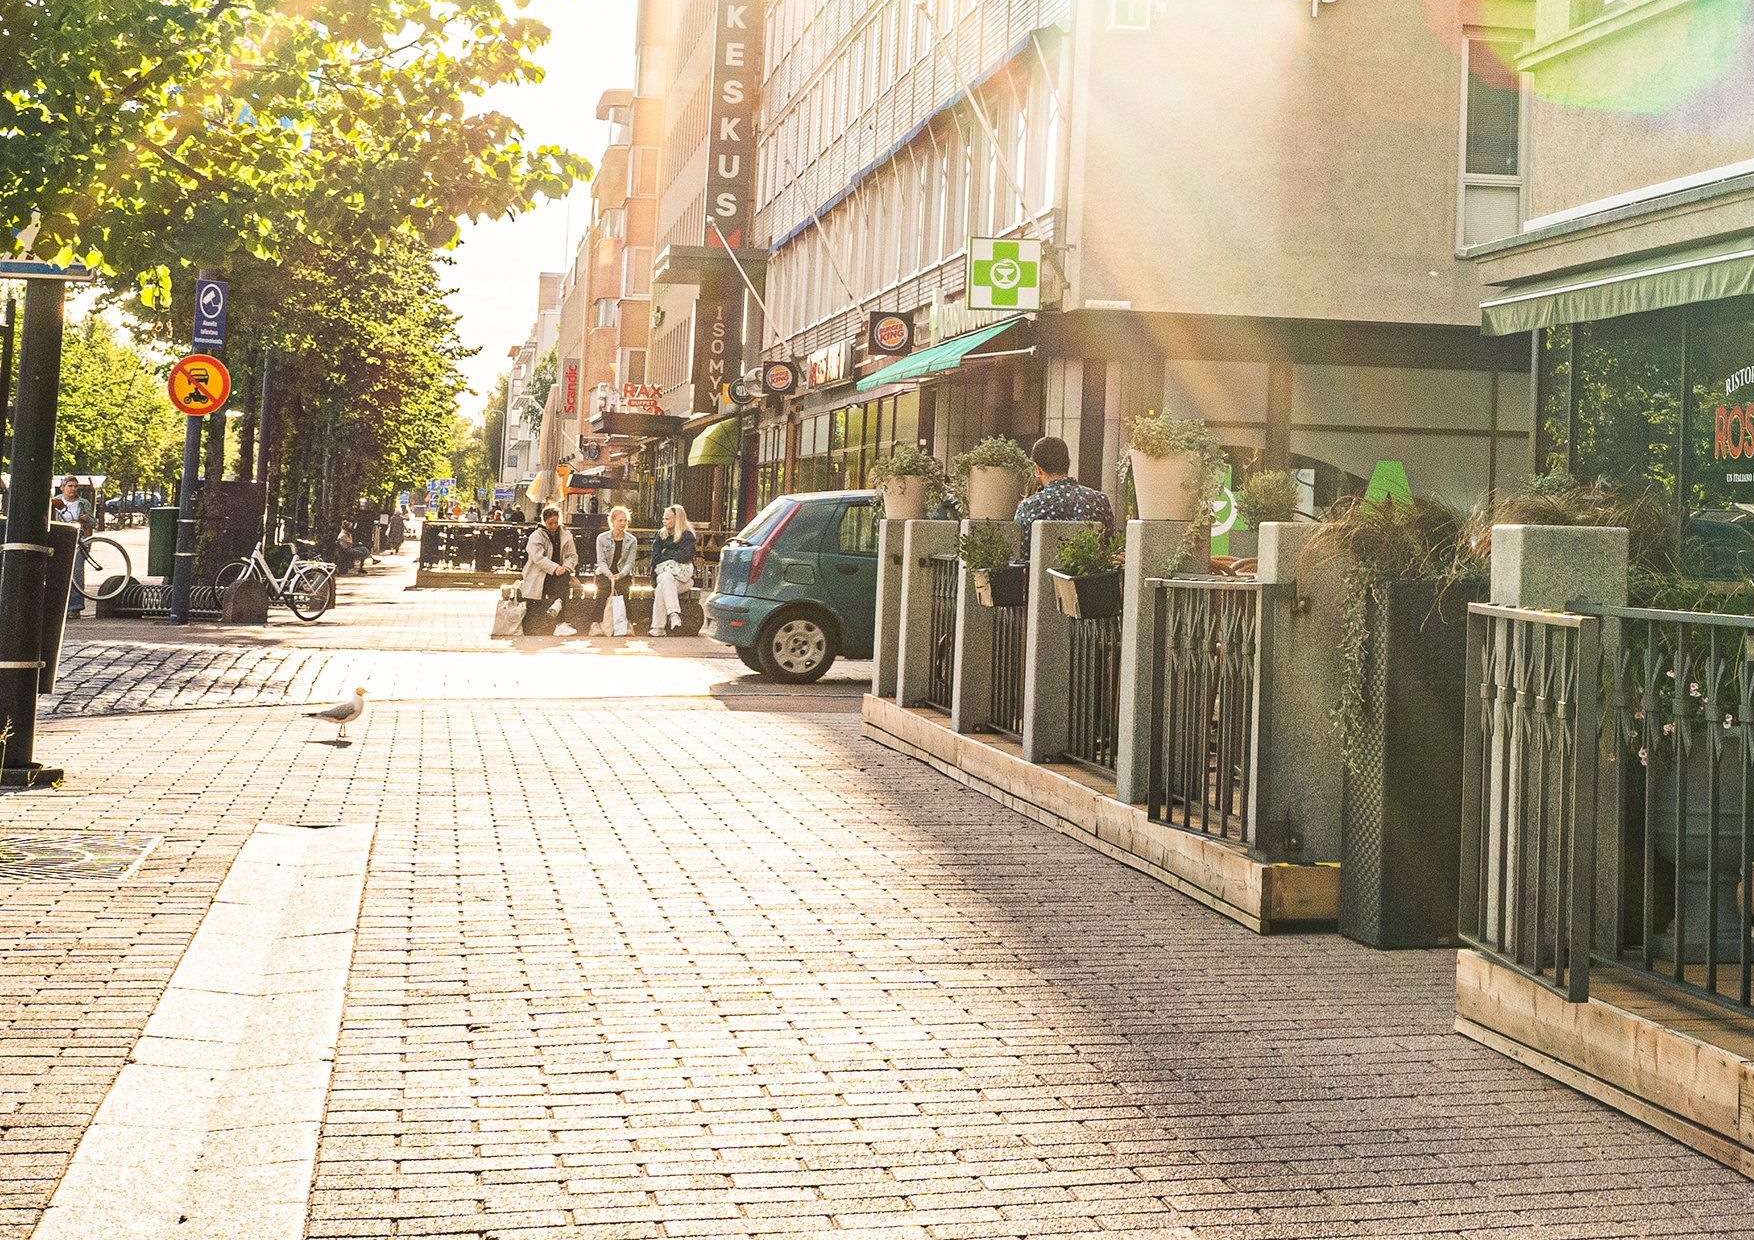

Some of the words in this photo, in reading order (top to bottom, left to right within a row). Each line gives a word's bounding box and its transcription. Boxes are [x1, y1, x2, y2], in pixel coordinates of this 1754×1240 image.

[879, 330, 904, 341] KING
[709, 306, 725, 407] ISOMYY
[564, 364, 577, 414] Scandic
[623, 383, 662, 399] RAX
